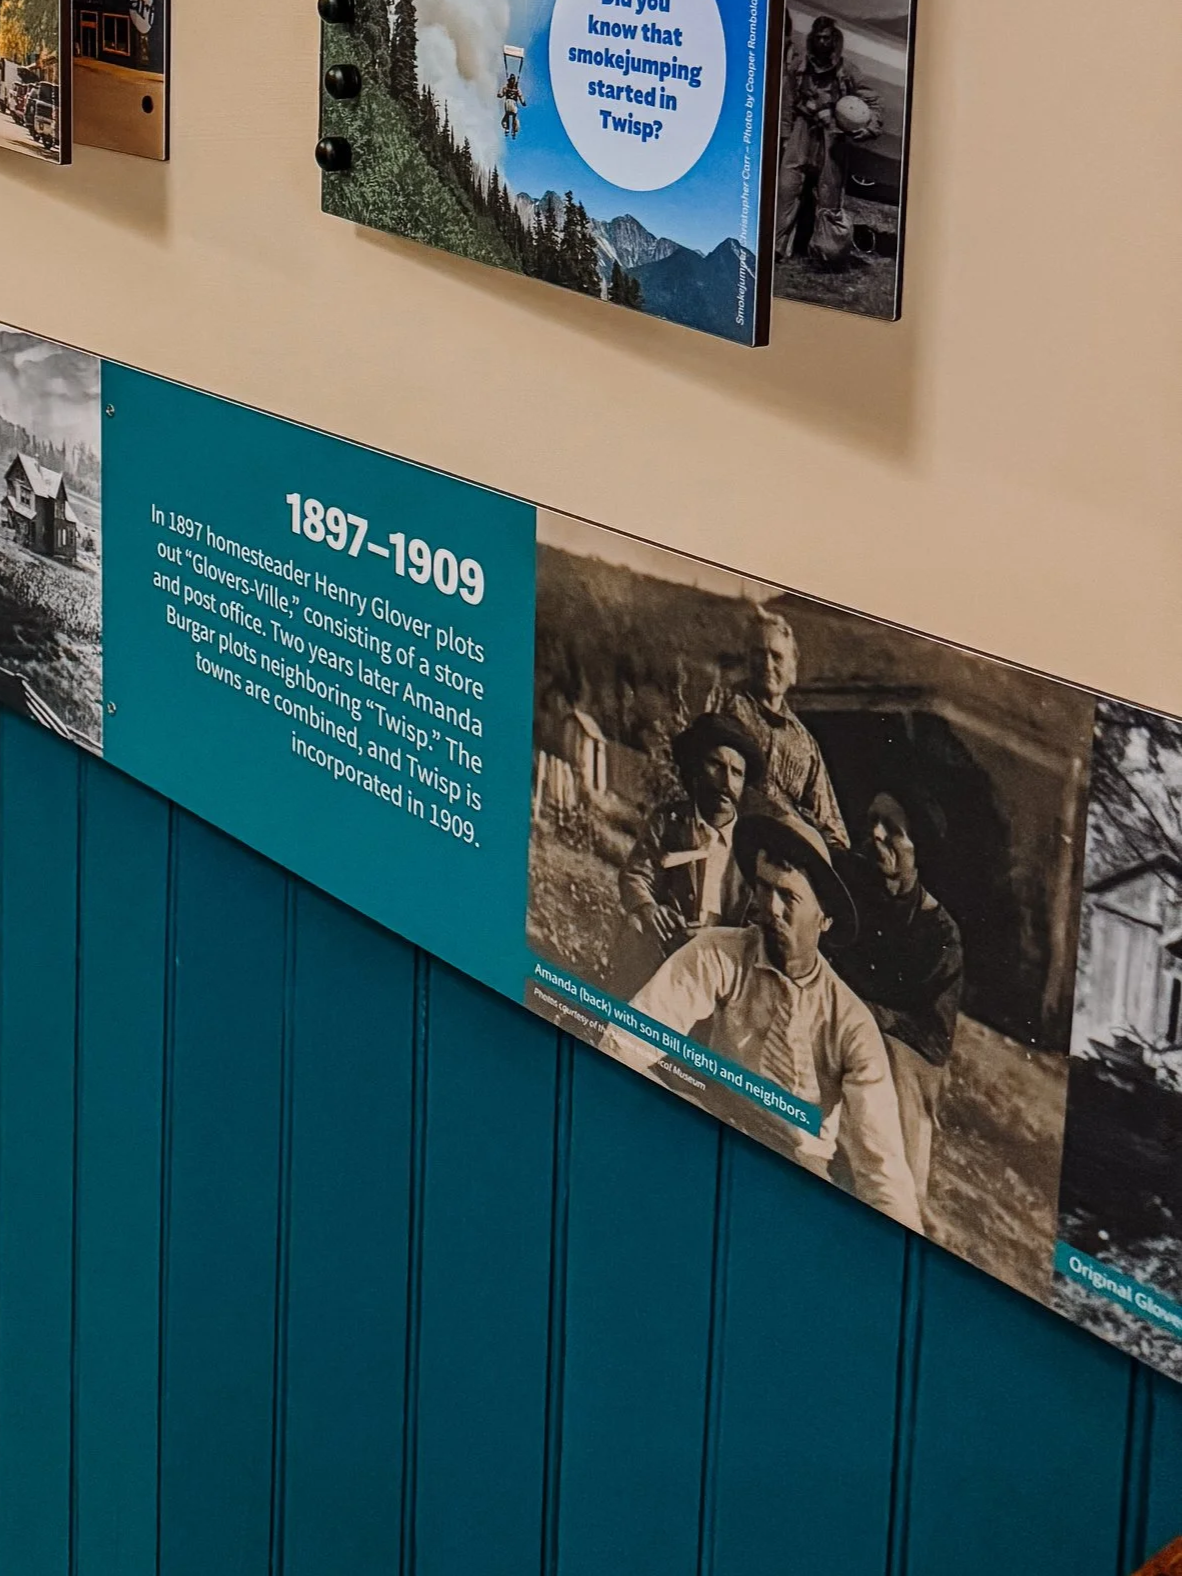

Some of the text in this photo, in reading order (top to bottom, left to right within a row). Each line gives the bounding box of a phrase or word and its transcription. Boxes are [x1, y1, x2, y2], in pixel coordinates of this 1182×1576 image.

[588, 14, 683, 47] know that
[568, 46, 703, 88] smokejumping
[745, 51, 757, 93] Cooper
[587, 80, 677, 111] started in
[744, 94, 756, 109] by
[599, 109, 663, 143] Twisp?
[743, 110, 754, 144] Photo
[742, 155, 752, 180] Carr
[735, 249, 747, 326] Smokejumper
[285, 492, 485, 606] 1897–1909
[151, 503, 484, 663] In 1897 homesteader Henry Glover plots
[157, 542, 183, 566] out
[303, 606, 393, 665] consisting
[395, 646, 416, 669] of
[419, 657, 430, 676] a
[434, 663, 484, 700] store
[153, 571, 484, 738] and post office. Two years later Amanda
[166, 603, 216, 643] Burgar
[219, 631, 257, 665] plots
[260, 652, 362, 722] neighboring
[445, 736, 483, 775] The
[195, 651, 483, 811] towns are combined, and Twisp is
[291, 730, 480, 848] incorporated in 1909.
[534, 963, 578, 995] Amanda
[579, 986, 612, 1017] (back)
[613, 1004, 638, 1030] with
[639, 1021, 660, 1042] son
[661, 1033, 681, 1054] Bill
[682, 1043, 719, 1075] (right)
[719, 1066, 743, 1088] and
[745, 1080, 811, 1125] neighbors.
[589, 1017, 599, 1029] of
[673, 1065, 707, 1091] Museum
[1069, 1256, 1133, 1303] Original
